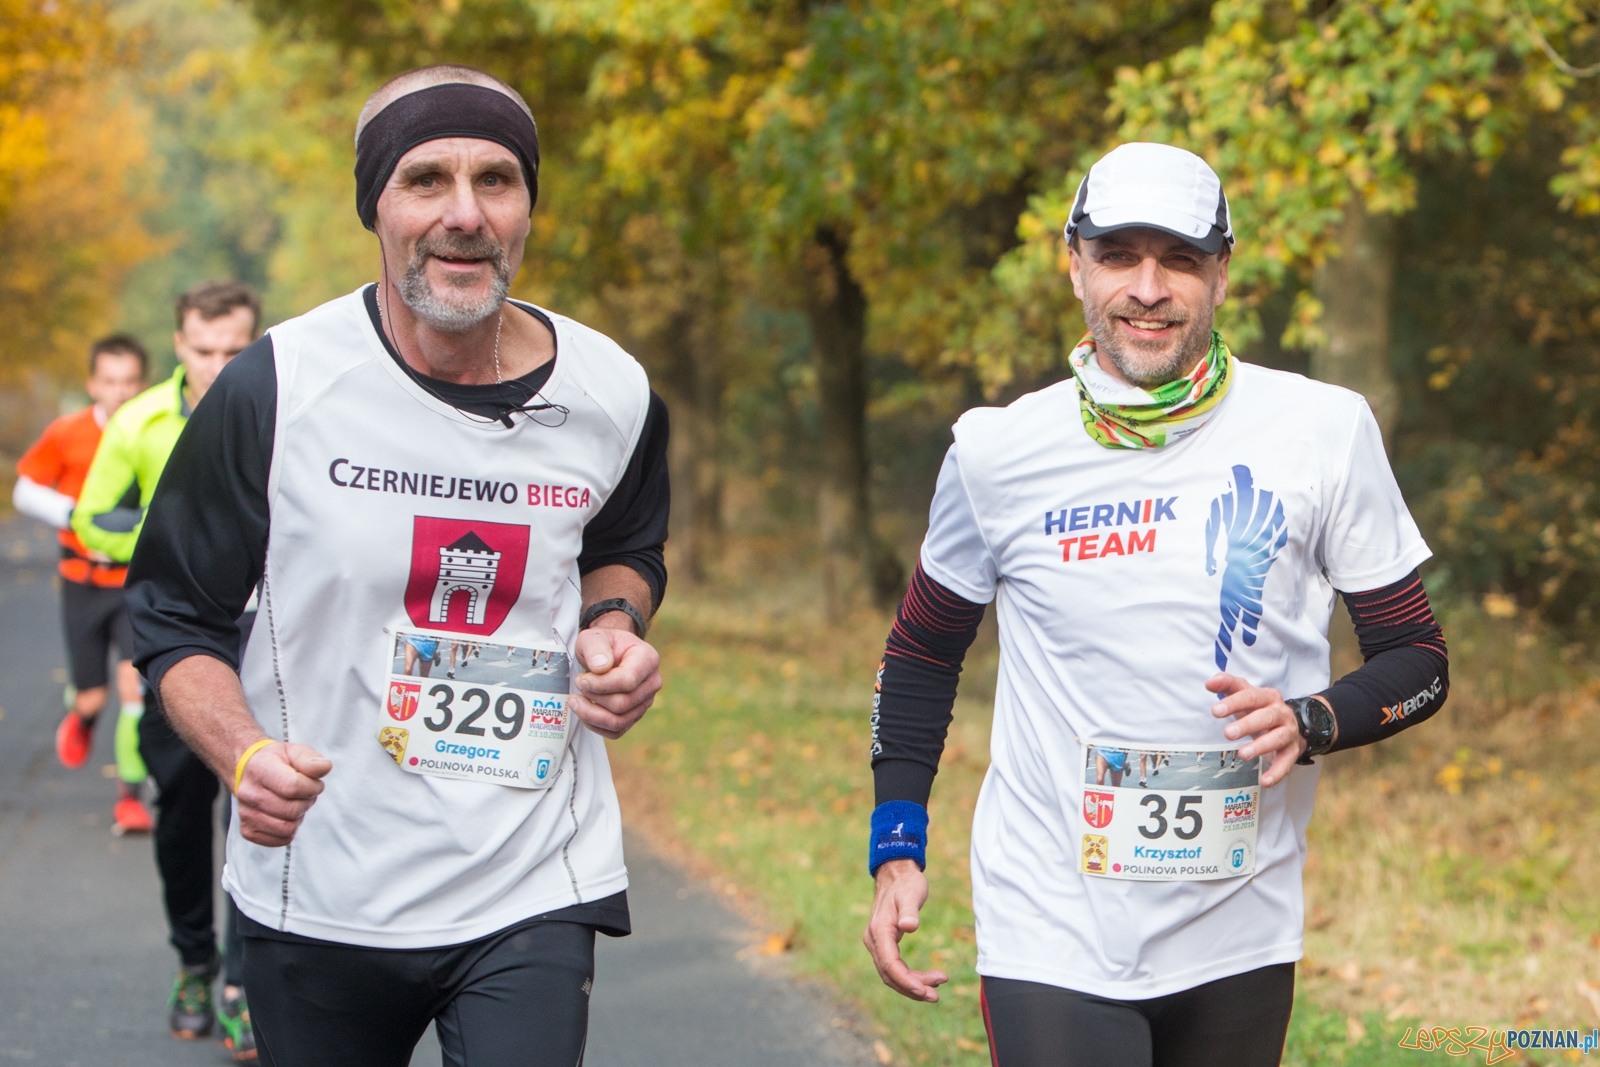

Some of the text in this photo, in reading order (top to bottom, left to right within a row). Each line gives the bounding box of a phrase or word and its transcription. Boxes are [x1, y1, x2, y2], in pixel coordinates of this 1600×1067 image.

[329, 458, 590, 508] CZERNIEJEWO BIEGA
[1045, 496, 1179, 535] HERNIK
[1058, 529, 1156, 562] TEAM
[424, 684, 525, 740] 329
[531, 707, 564, 718] MARATON
[528, 730, 564, 739] 23.10.2016
[435, 739, 501, 760] Grzegorz
[420, 757, 474, 773] POLINOVA
[477, 766, 520, 779] POLSKA
[1224, 801, 1253, 811] MARATON
[1138, 794, 1203, 840] 35
[1223, 821, 1255, 832] 23.10.2016
[1134, 845, 1202, 862] Krzysztof
[1123, 864, 1219, 875] POLINOVA POLSKA
